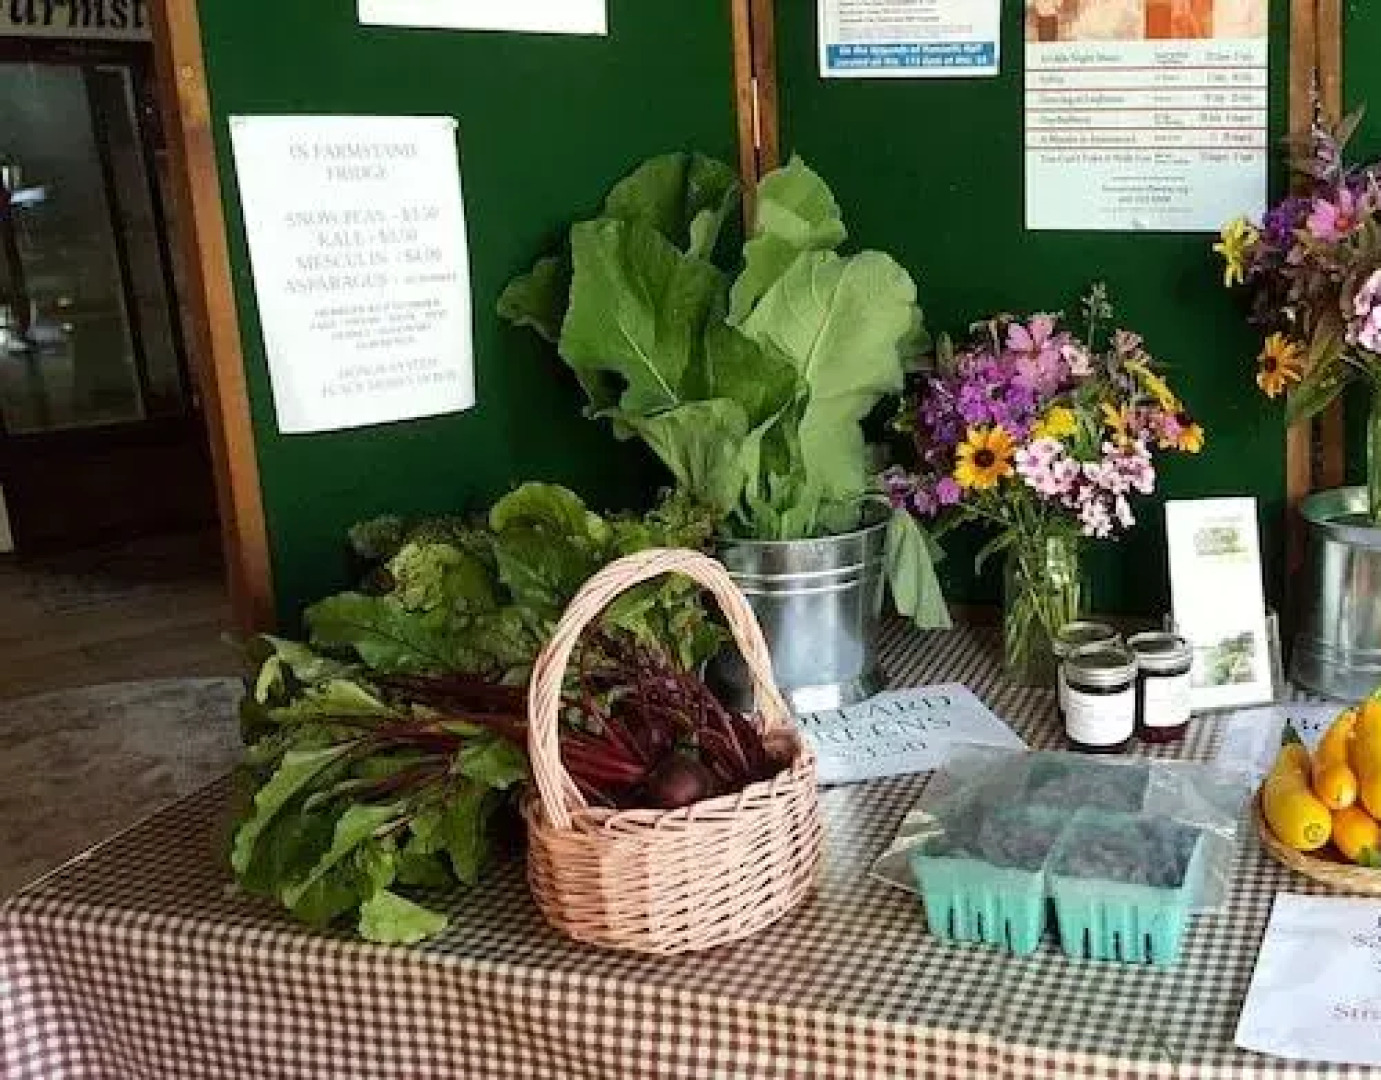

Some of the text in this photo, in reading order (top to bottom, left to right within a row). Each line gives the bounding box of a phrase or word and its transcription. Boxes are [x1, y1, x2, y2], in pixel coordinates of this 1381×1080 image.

[326, 165, 388, 182] FRIDGE
[318, 230, 362, 247] KALE
[285, 273, 387, 295] ASPARAGUS
[800, 695, 951, 727] LLARD
[813, 717, 952, 745] REENS
